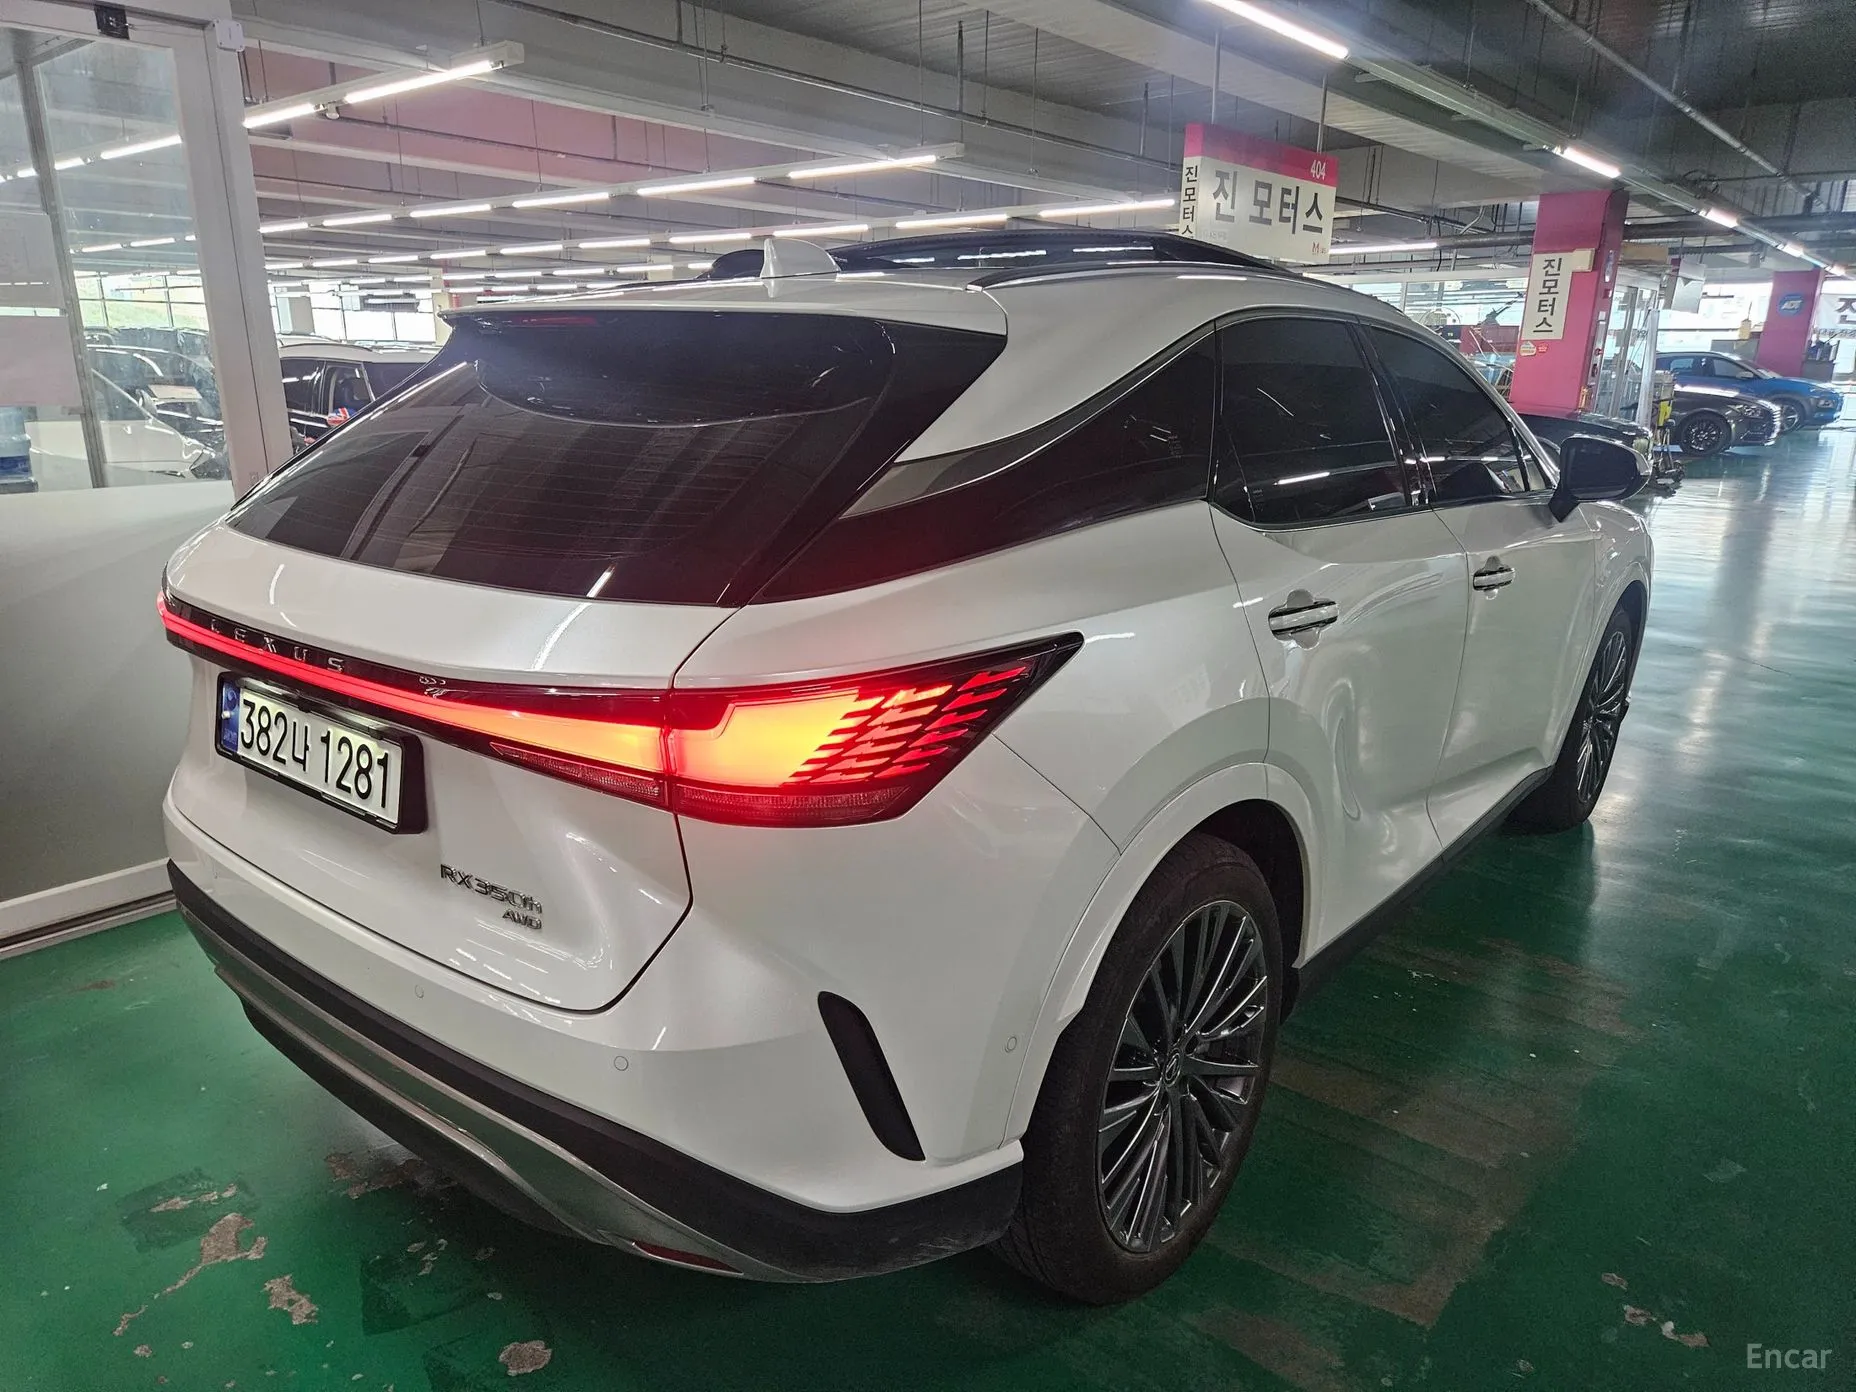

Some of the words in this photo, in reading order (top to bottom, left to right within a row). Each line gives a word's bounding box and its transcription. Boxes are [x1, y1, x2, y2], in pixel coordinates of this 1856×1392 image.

[1310, 159, 1327, 181] 404
[1181, 165, 1198, 238] 진모터스
[1532, 257, 1563, 333] 진모터스
[210, 618, 345, 674] LEXUS
[240, 699, 310, 772] 382나
[320, 729, 389, 809] 1281
[440, 863, 473, 889] RX
[502, 908, 542, 929] AWD
